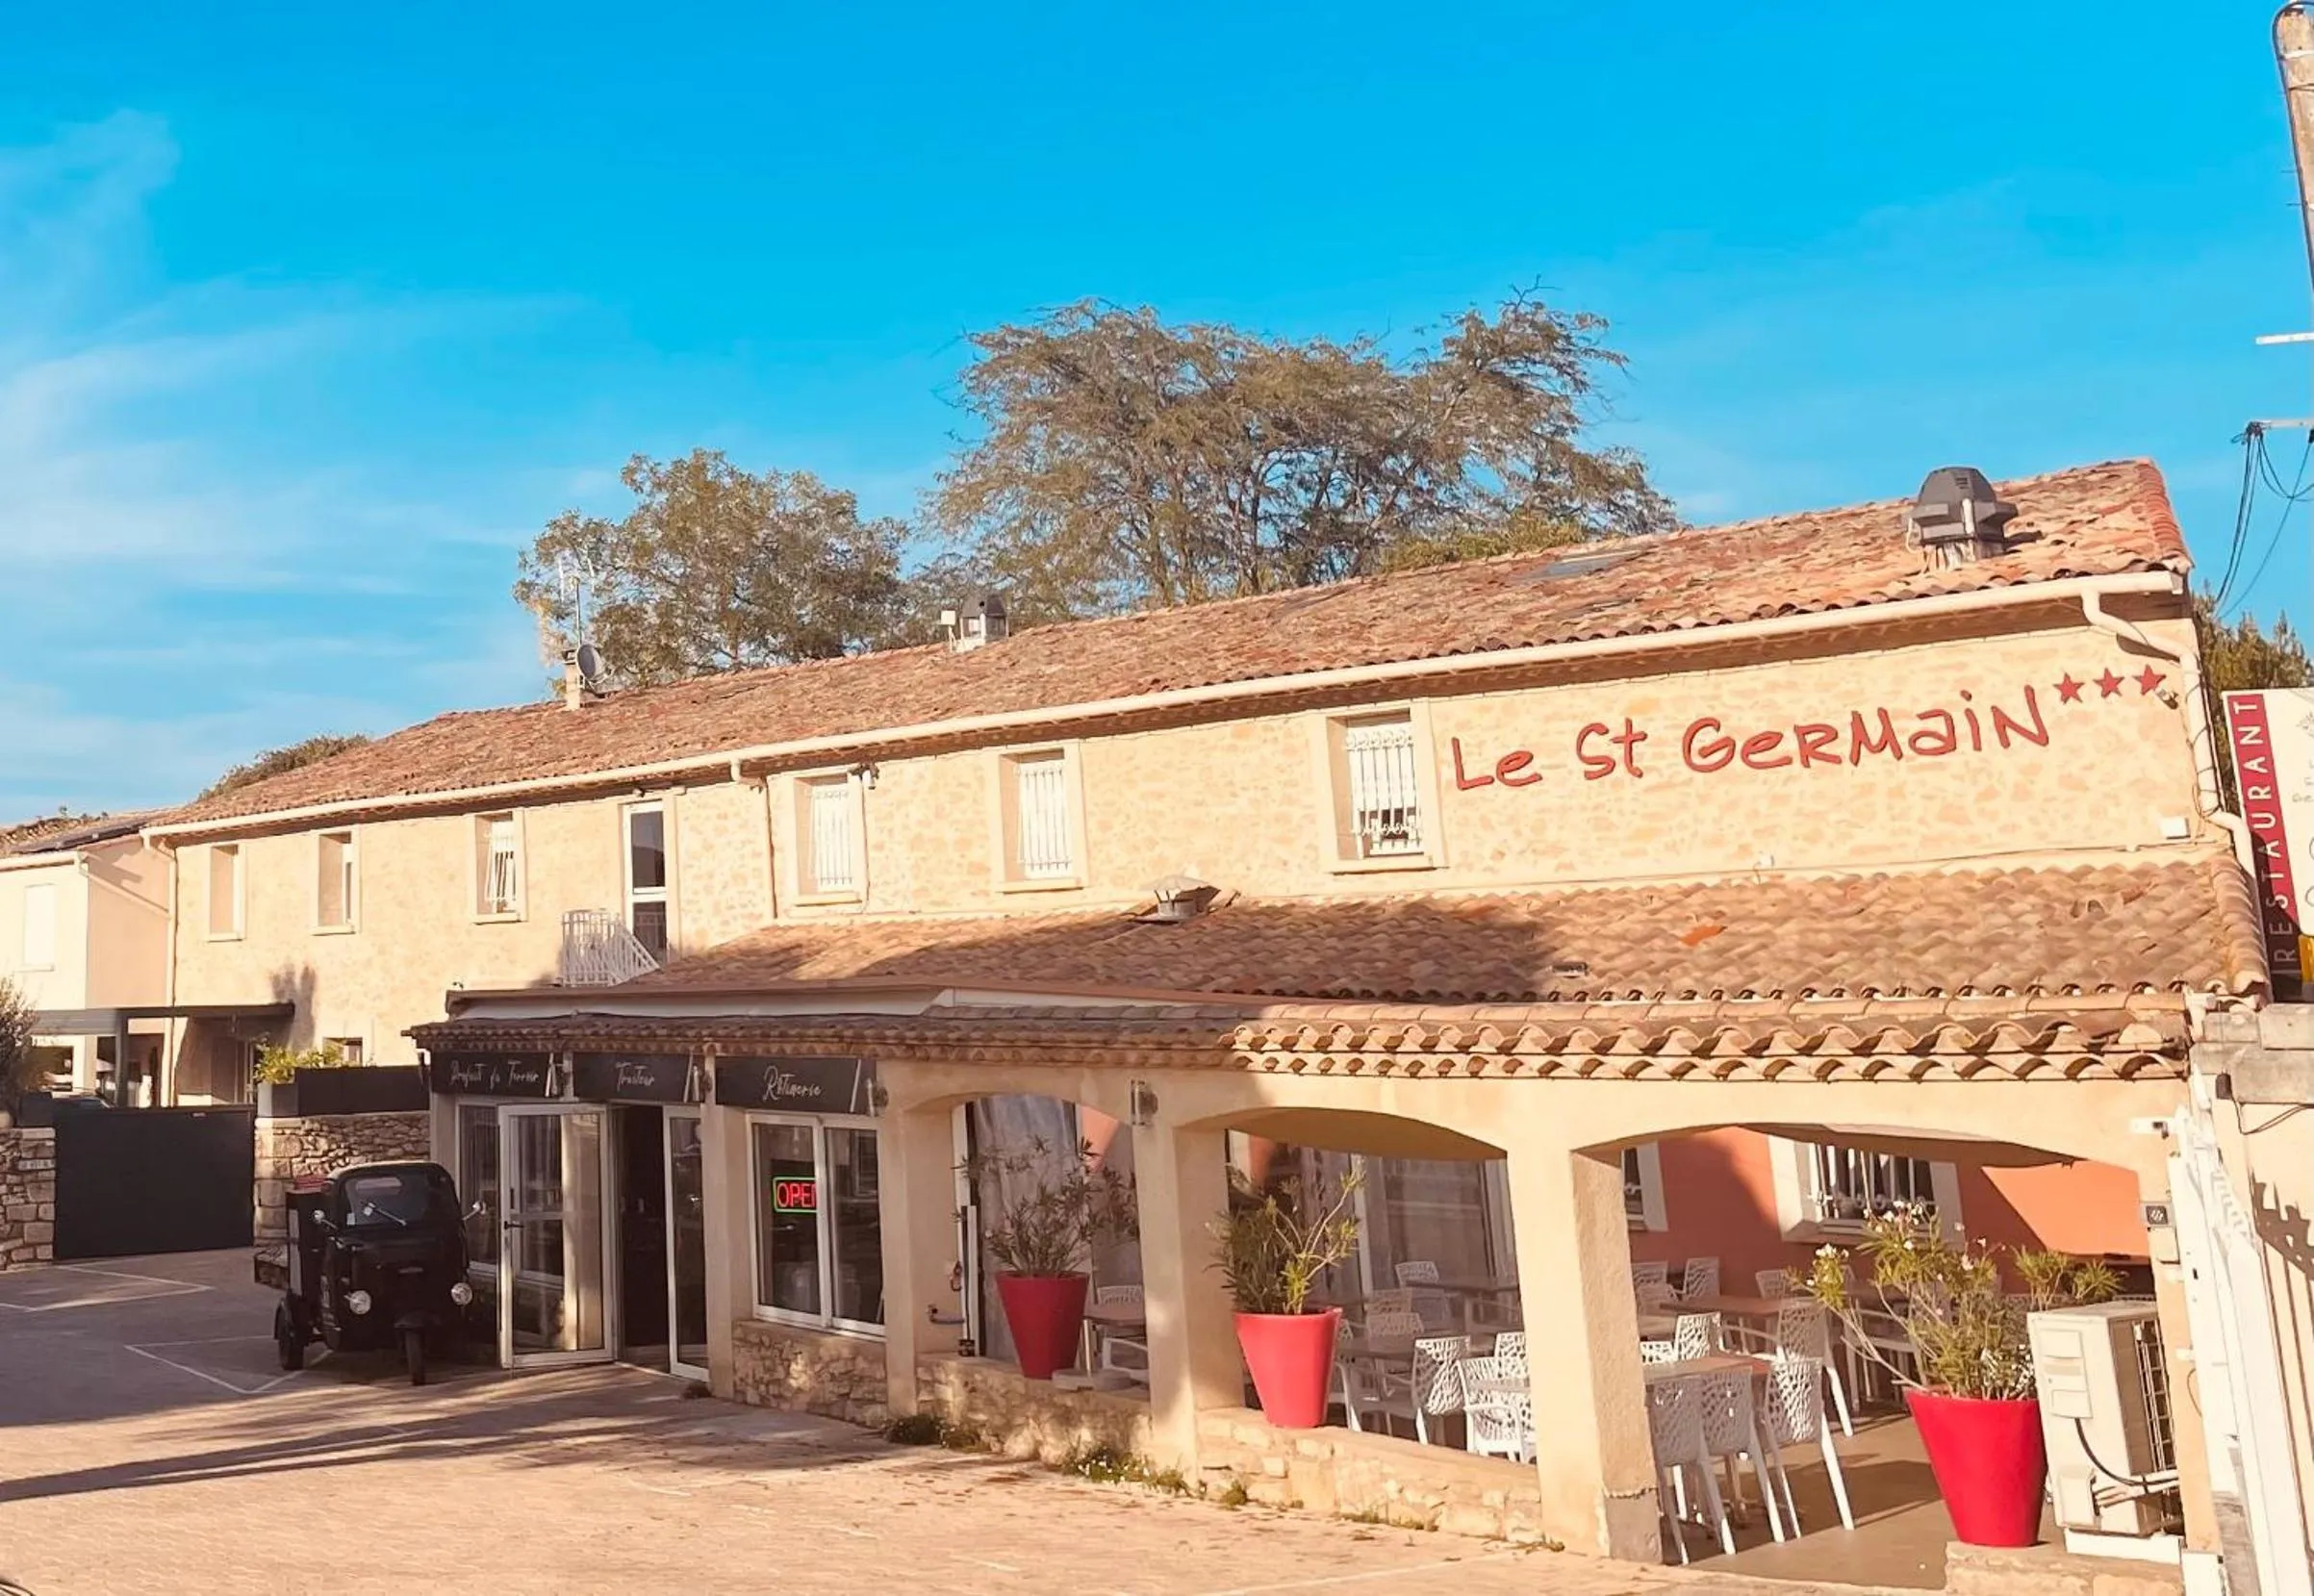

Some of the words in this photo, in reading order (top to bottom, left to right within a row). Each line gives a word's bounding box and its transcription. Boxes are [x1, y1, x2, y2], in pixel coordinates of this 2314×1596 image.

[1453, 737, 1540, 791] Le
[1576, 718, 1648, 781] St
[2233, 700, 2299, 963] RESTAURANT
